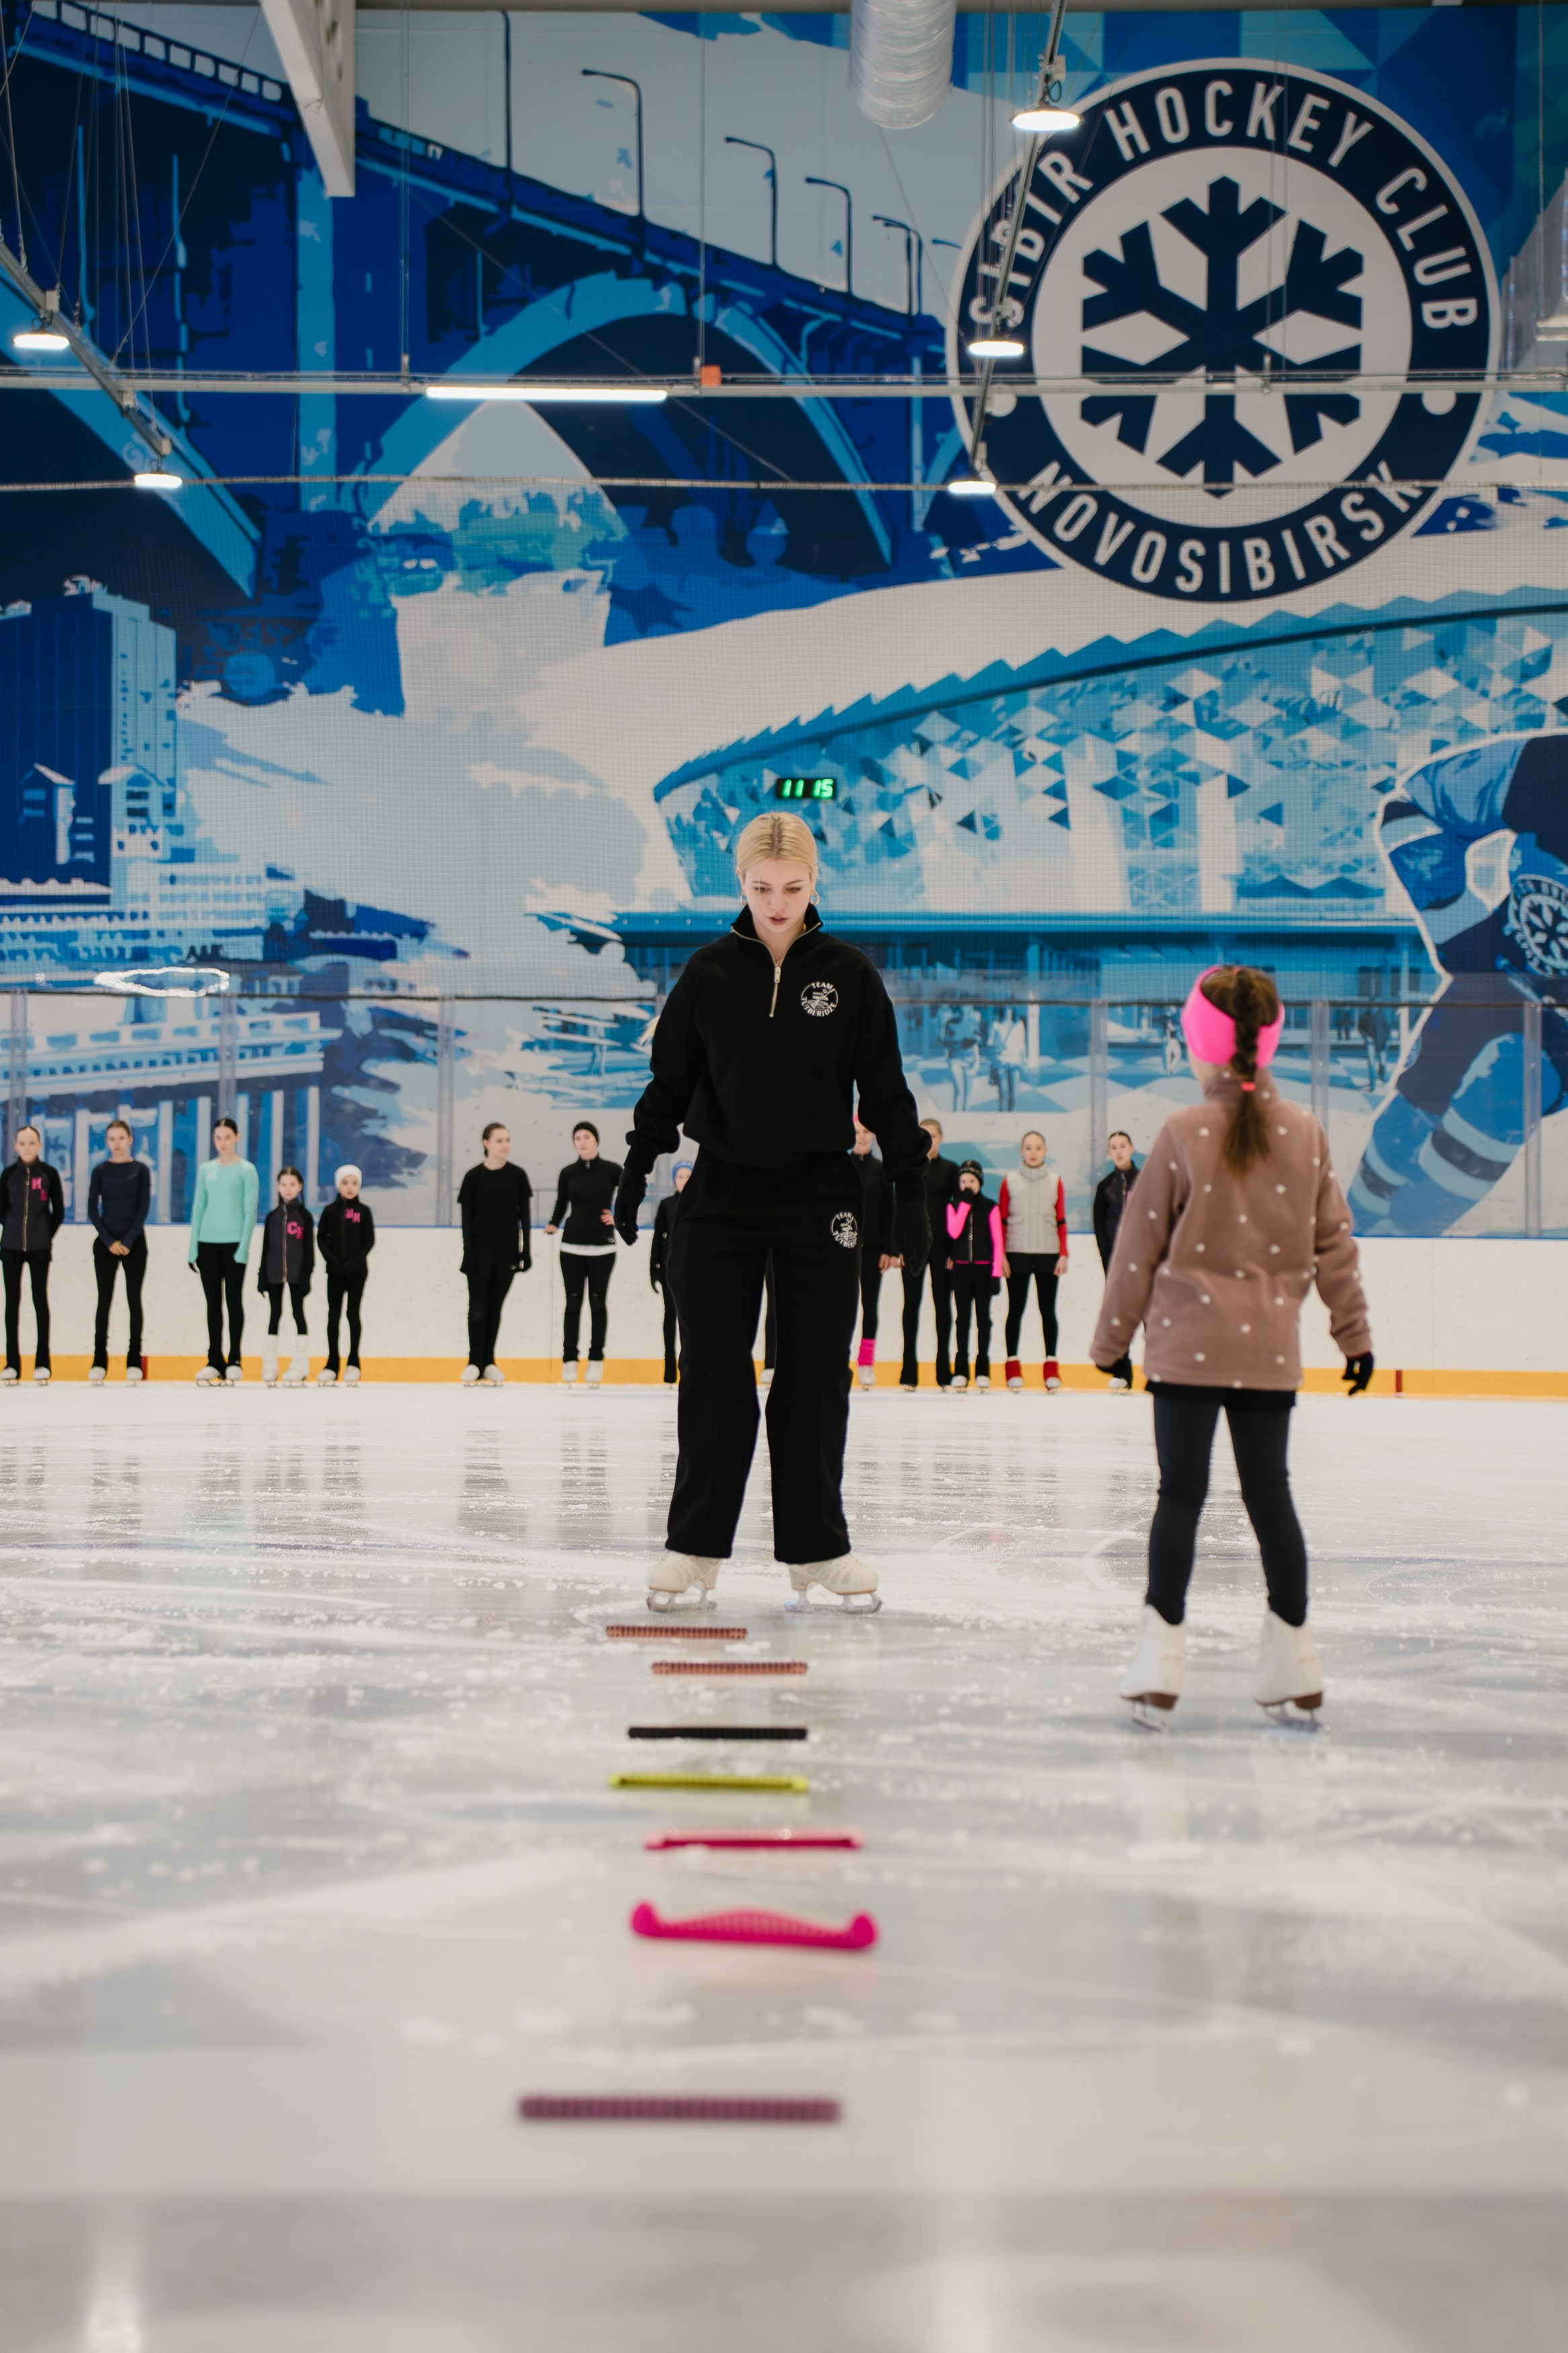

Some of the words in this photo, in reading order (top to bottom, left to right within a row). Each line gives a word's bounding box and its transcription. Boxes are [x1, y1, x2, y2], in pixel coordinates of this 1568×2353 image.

[968, 151, 1094, 328] SIBIR
[1104, 79, 1374, 169] HOCKEY
[1374, 167, 1478, 329] CLUB
[1018, 458, 1423, 594] NOVOSIBIRSK
[811, 982, 834, 990] TEAM
[800, 996, 837, 1016] TUTBERIDZE
[835, 1211, 853, 1220] TEAM
